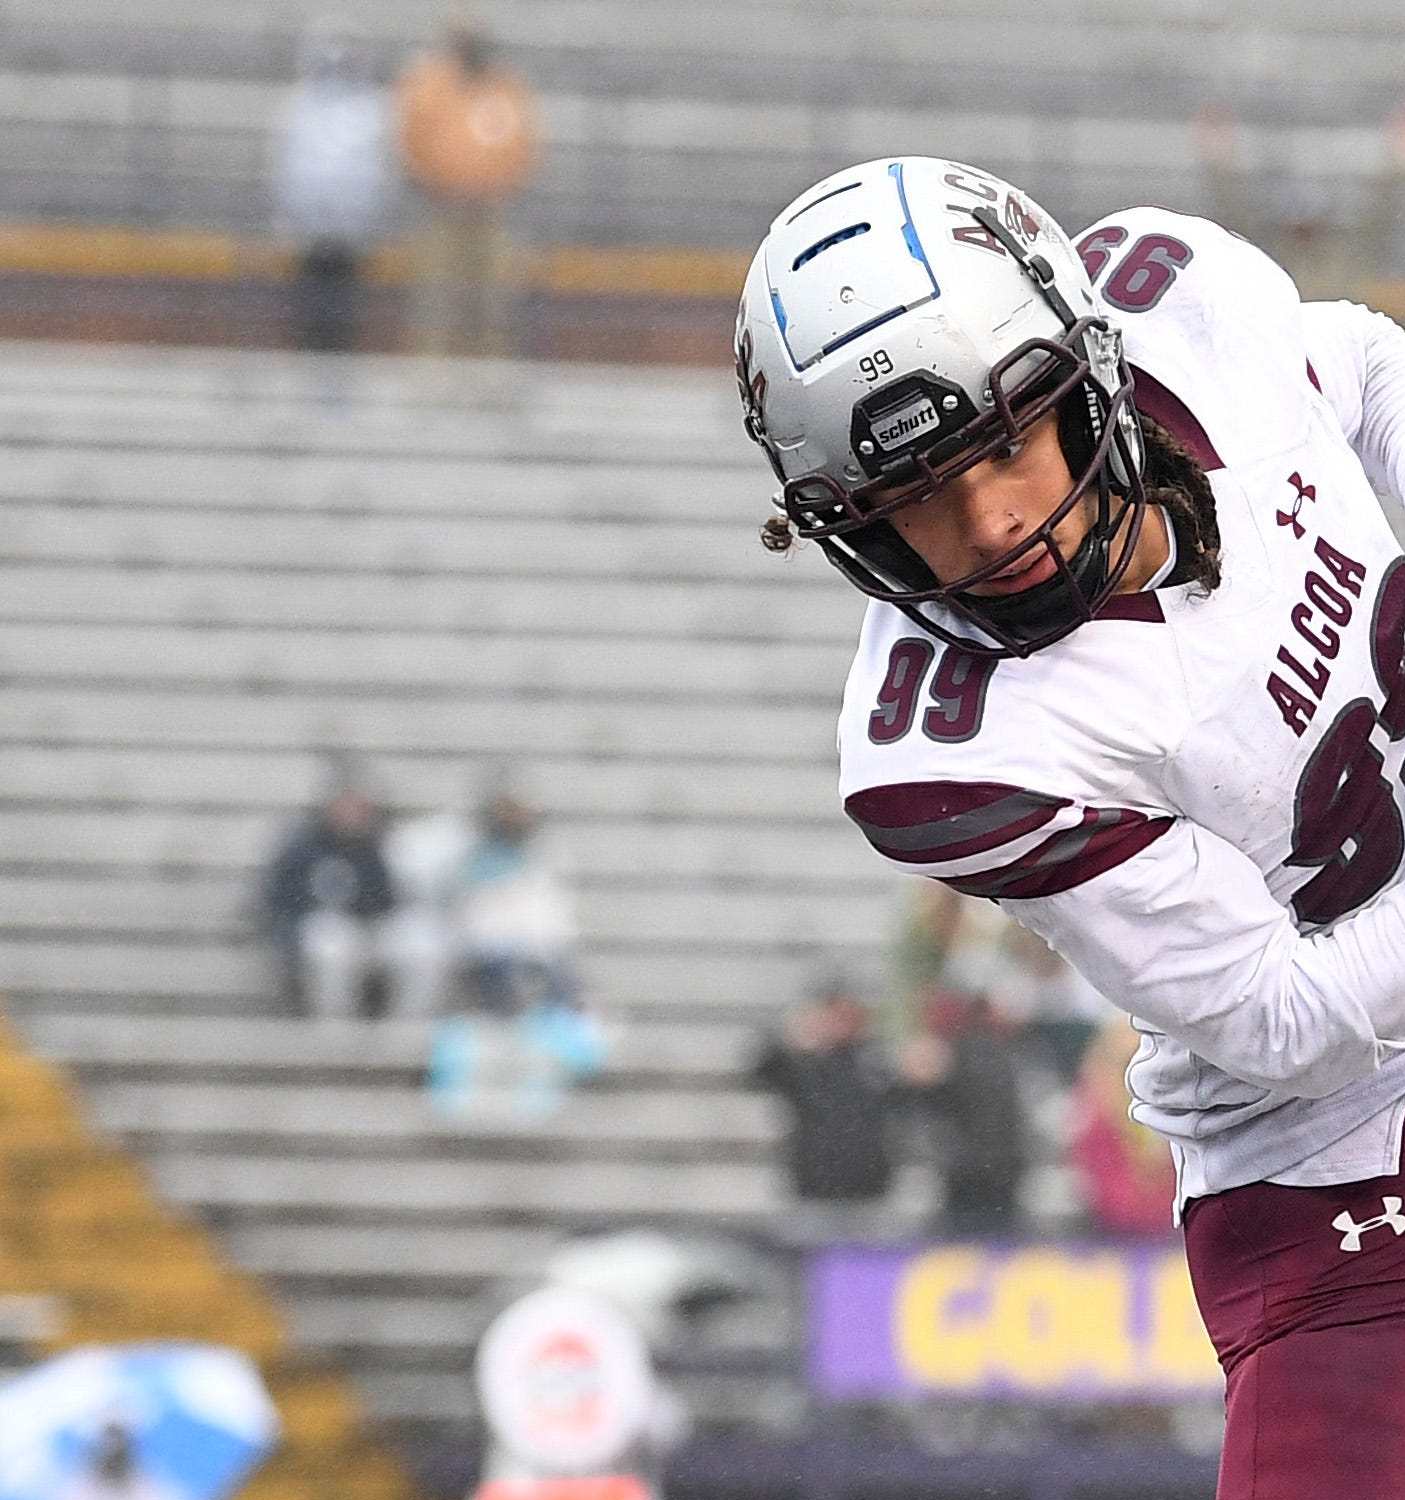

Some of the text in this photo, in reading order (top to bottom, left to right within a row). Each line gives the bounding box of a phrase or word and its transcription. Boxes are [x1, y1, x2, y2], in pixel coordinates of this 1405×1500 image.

[859, 348, 895, 382] 99
[878, 404, 936, 445] schutt
[1266, 535, 1368, 738] ALCOA
[867, 636, 1000, 746] 99
